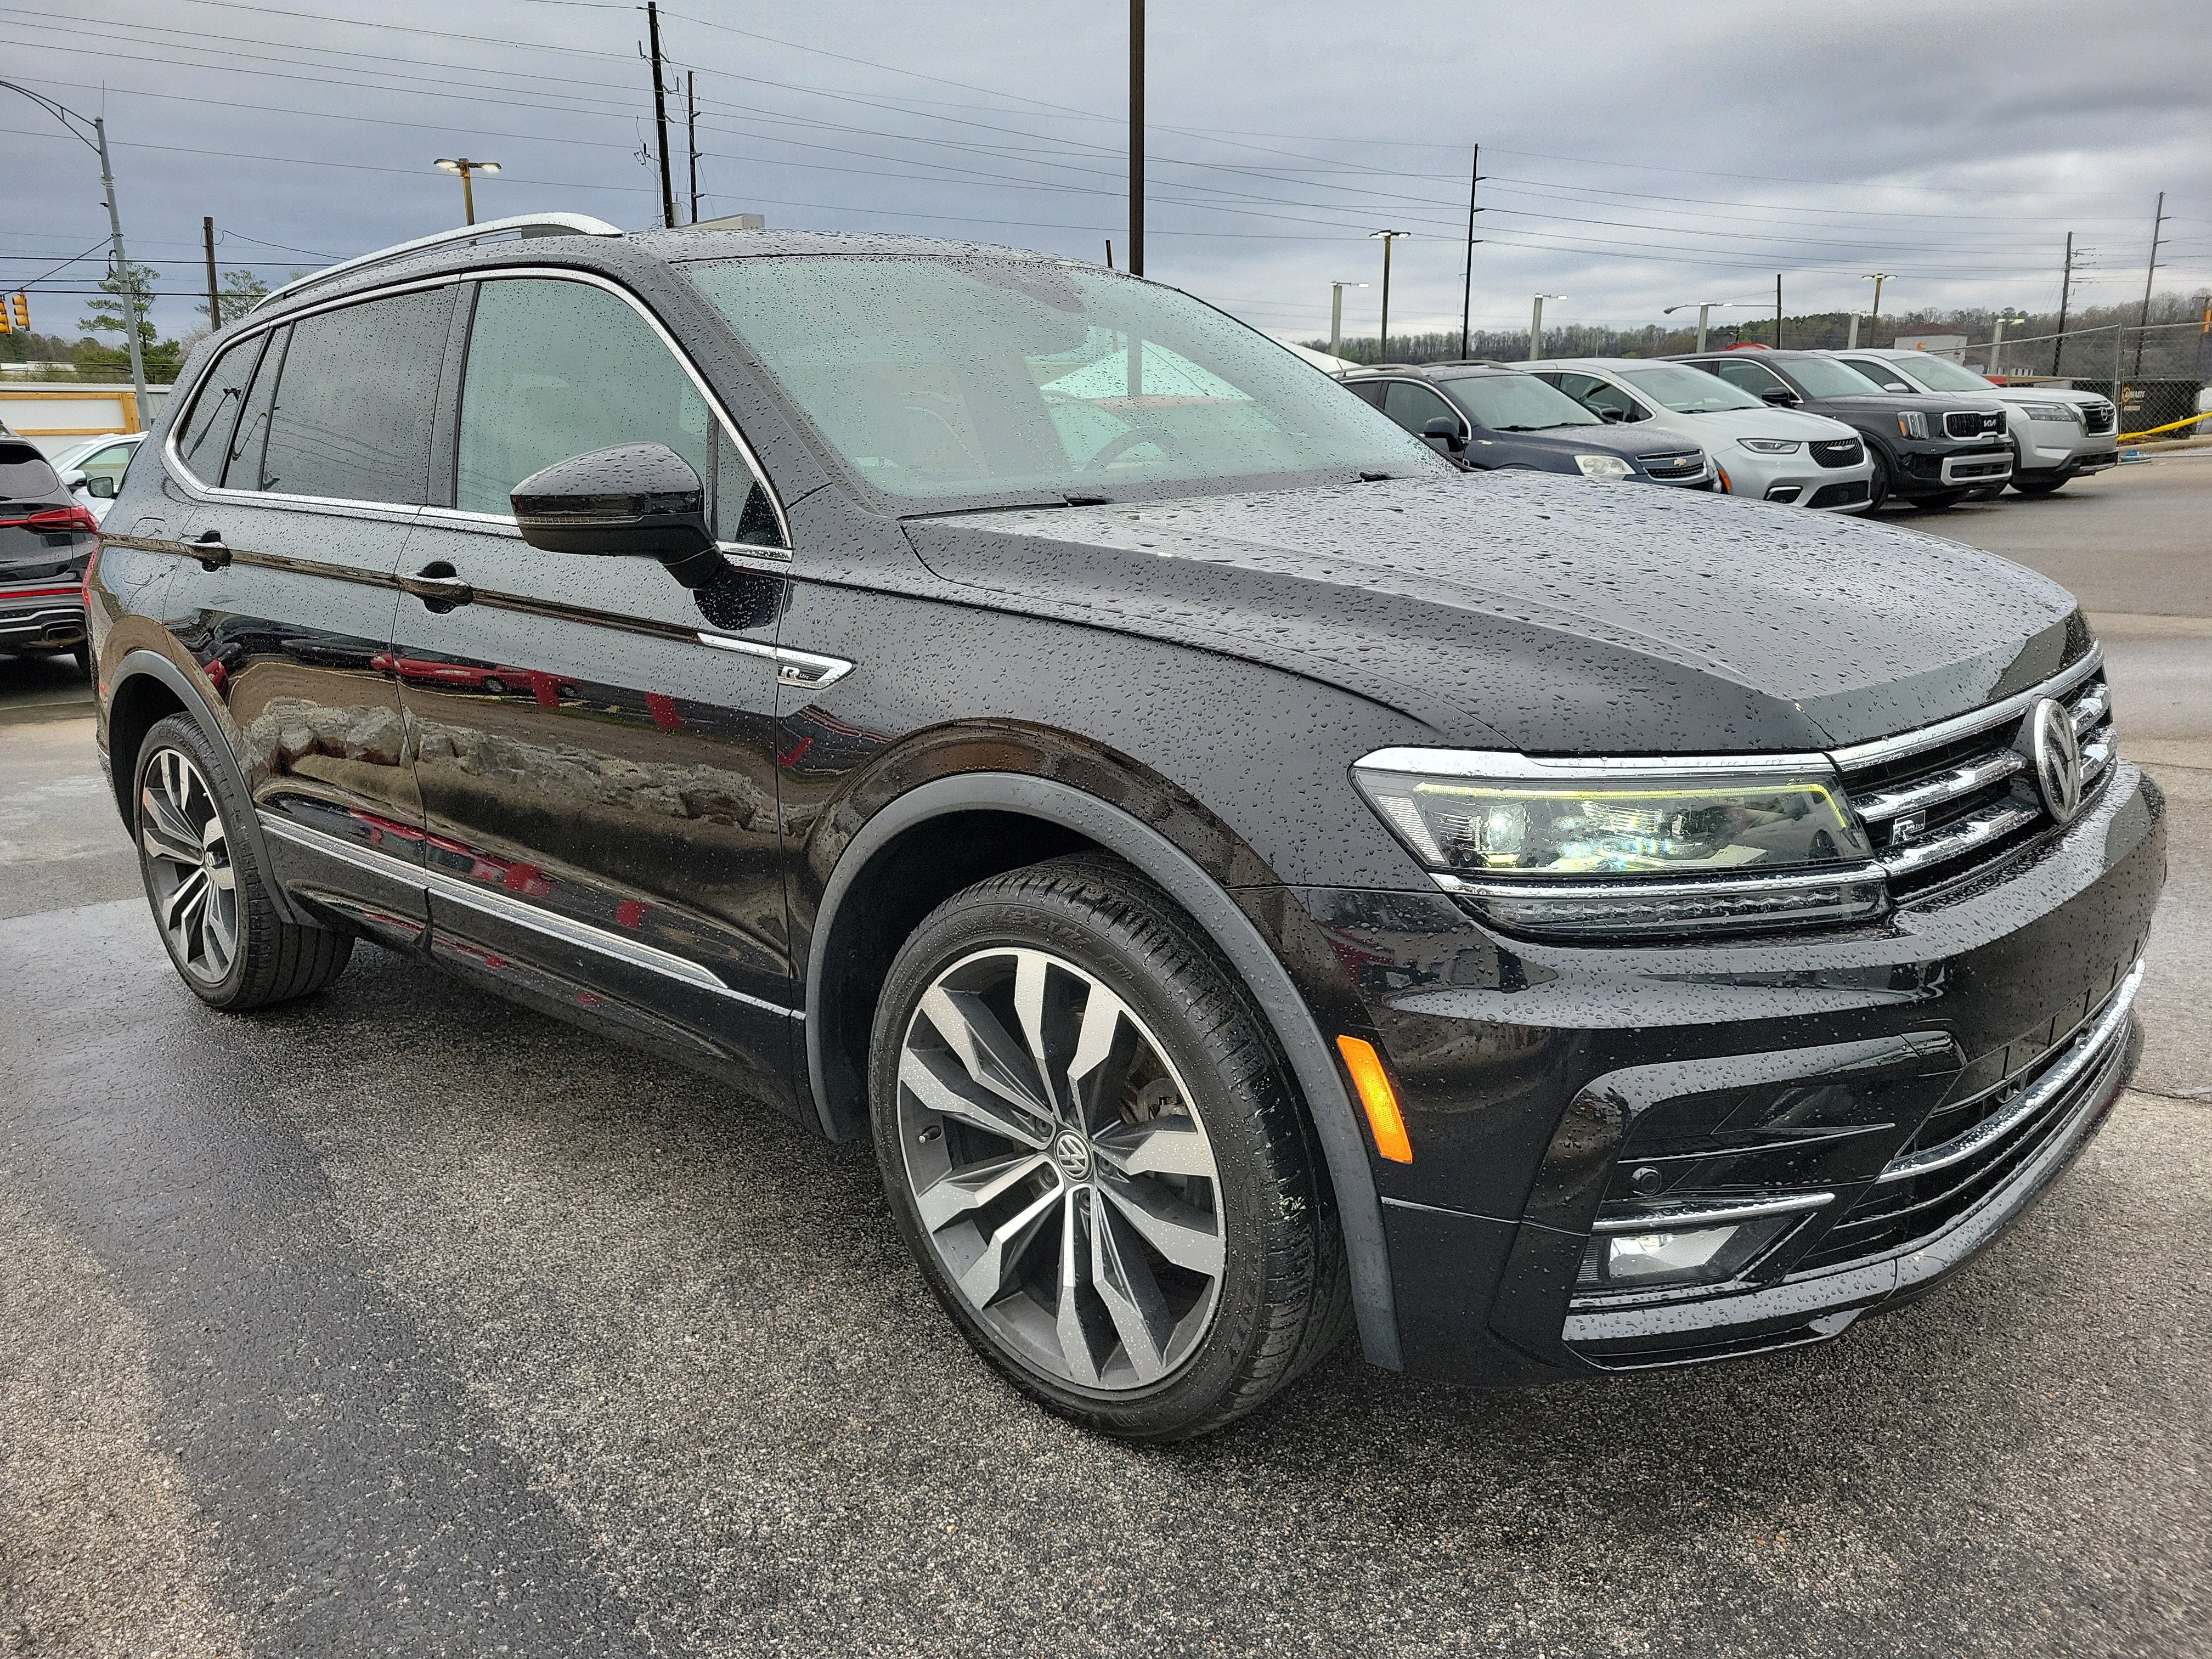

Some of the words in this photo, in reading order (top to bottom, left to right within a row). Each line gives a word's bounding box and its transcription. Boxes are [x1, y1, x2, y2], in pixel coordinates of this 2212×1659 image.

[1983, 419, 1996, 427] KIA
[781, 665, 800, 681] R
[1892, 820, 1914, 845] R
